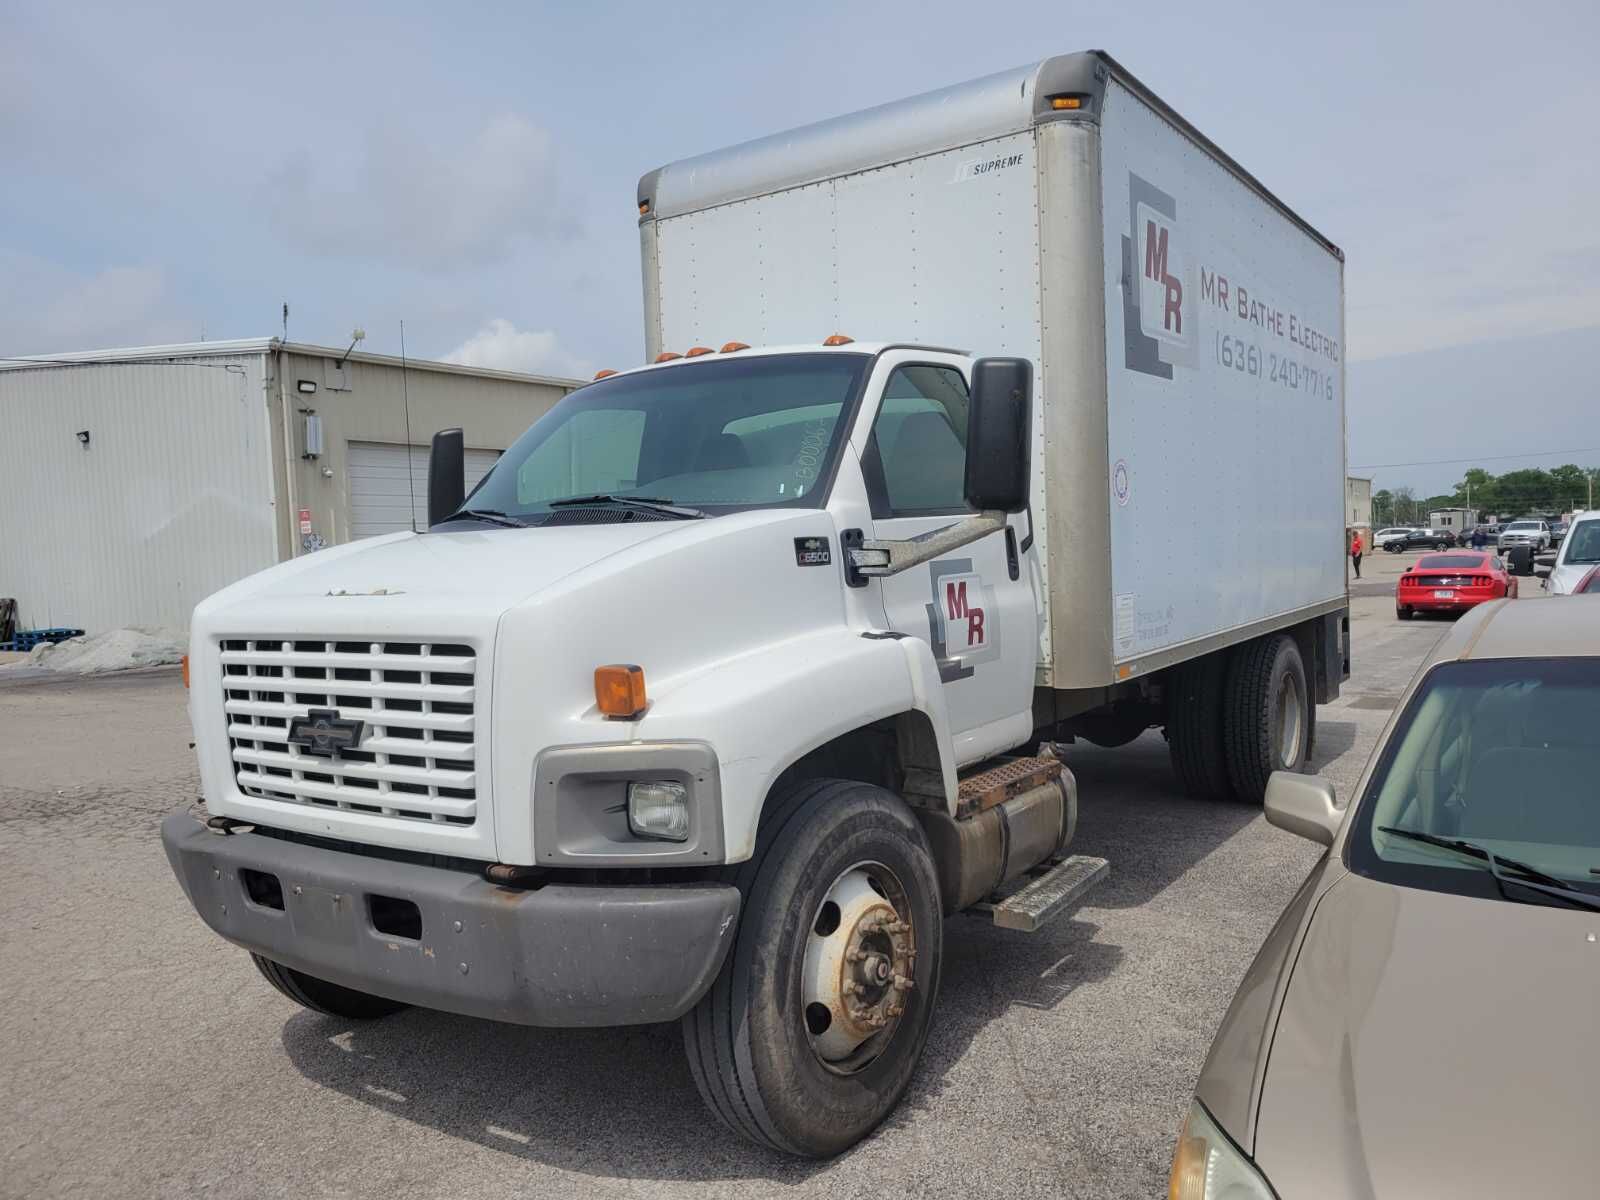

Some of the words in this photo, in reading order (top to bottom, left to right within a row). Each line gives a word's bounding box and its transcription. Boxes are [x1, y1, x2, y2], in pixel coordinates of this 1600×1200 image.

[973, 153, 1024, 176] SUPREME
[1201, 264, 1229, 312] MR
[1237, 286, 1284, 337] BATHE
[1290, 313, 1339, 362] ELECTRIC
[1216, 329, 1263, 380] (636)
